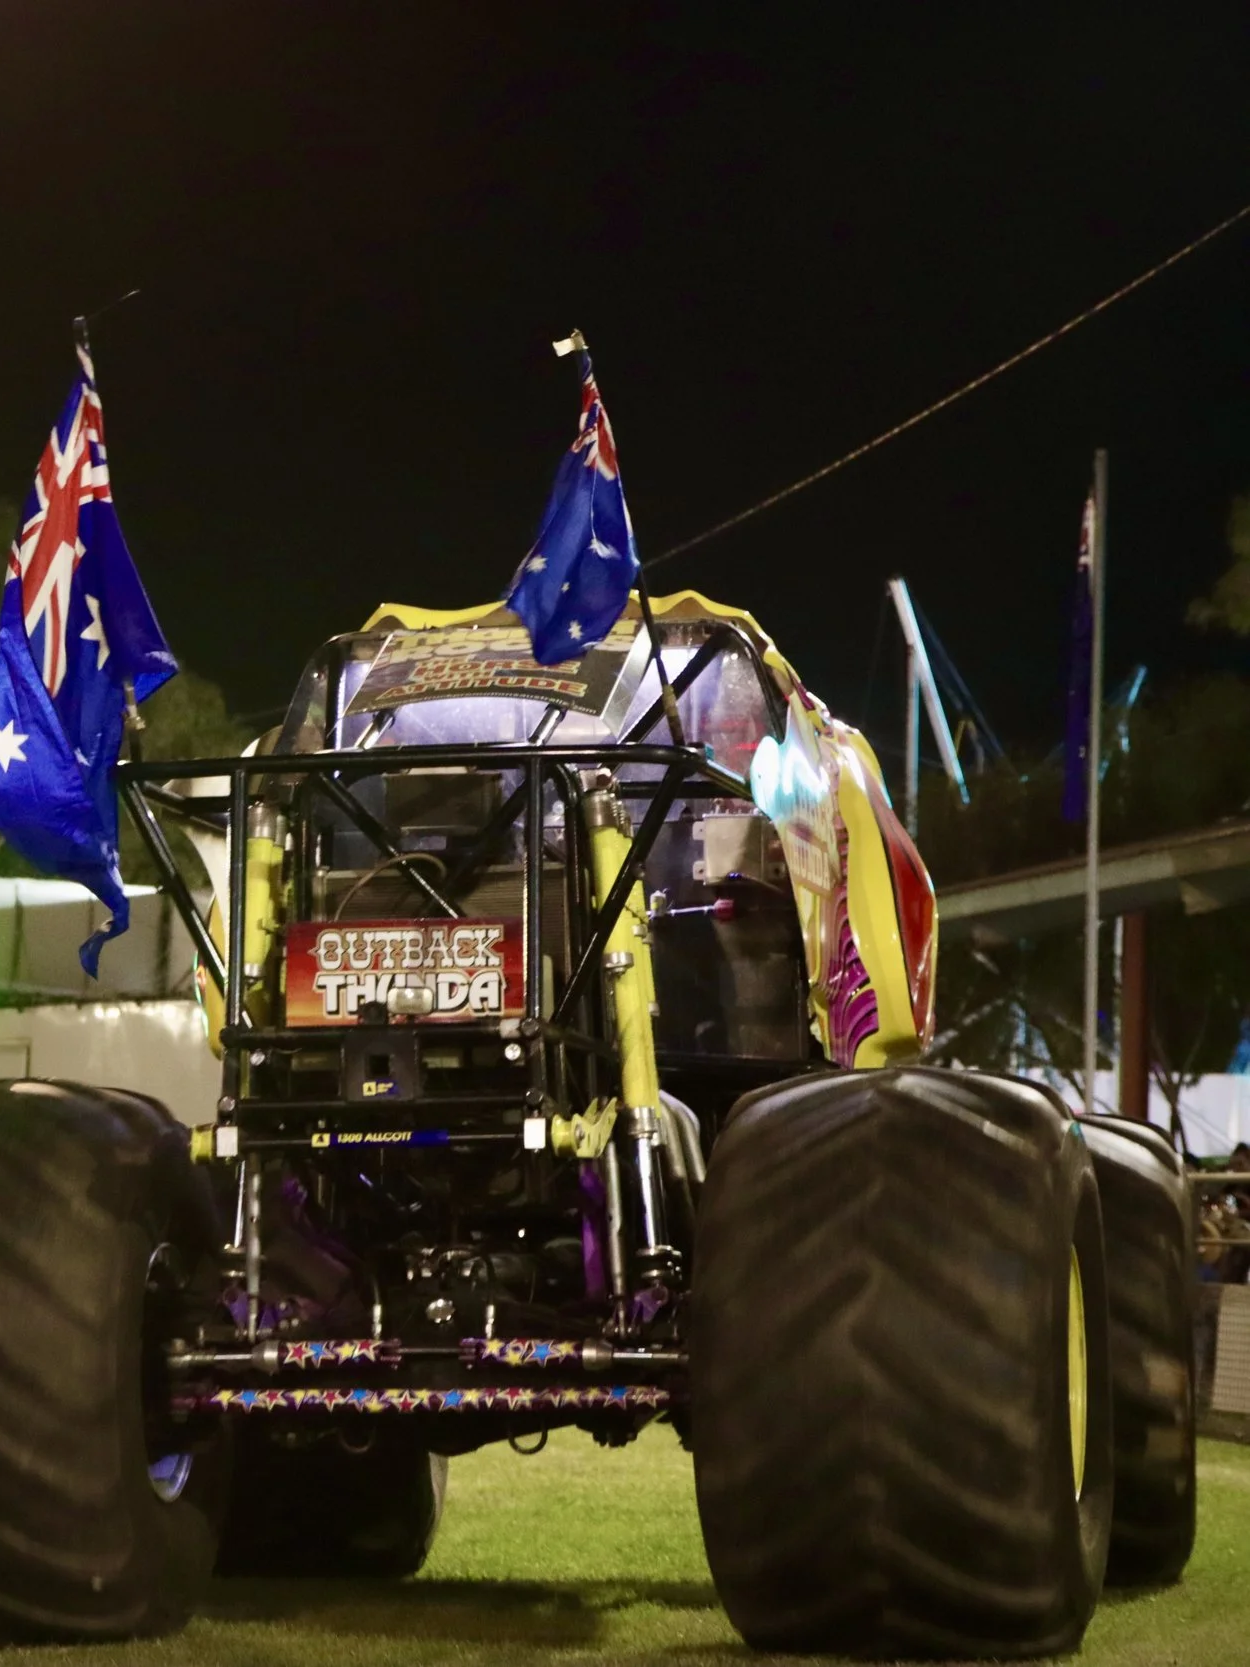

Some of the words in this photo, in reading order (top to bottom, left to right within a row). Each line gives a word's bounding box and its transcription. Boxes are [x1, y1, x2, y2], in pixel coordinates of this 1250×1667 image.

[375, 676, 588, 701] ATTITUDE
[316, 928, 503, 971] OUTBACK
[364, 1131, 413, 1143] ALLCOTT
